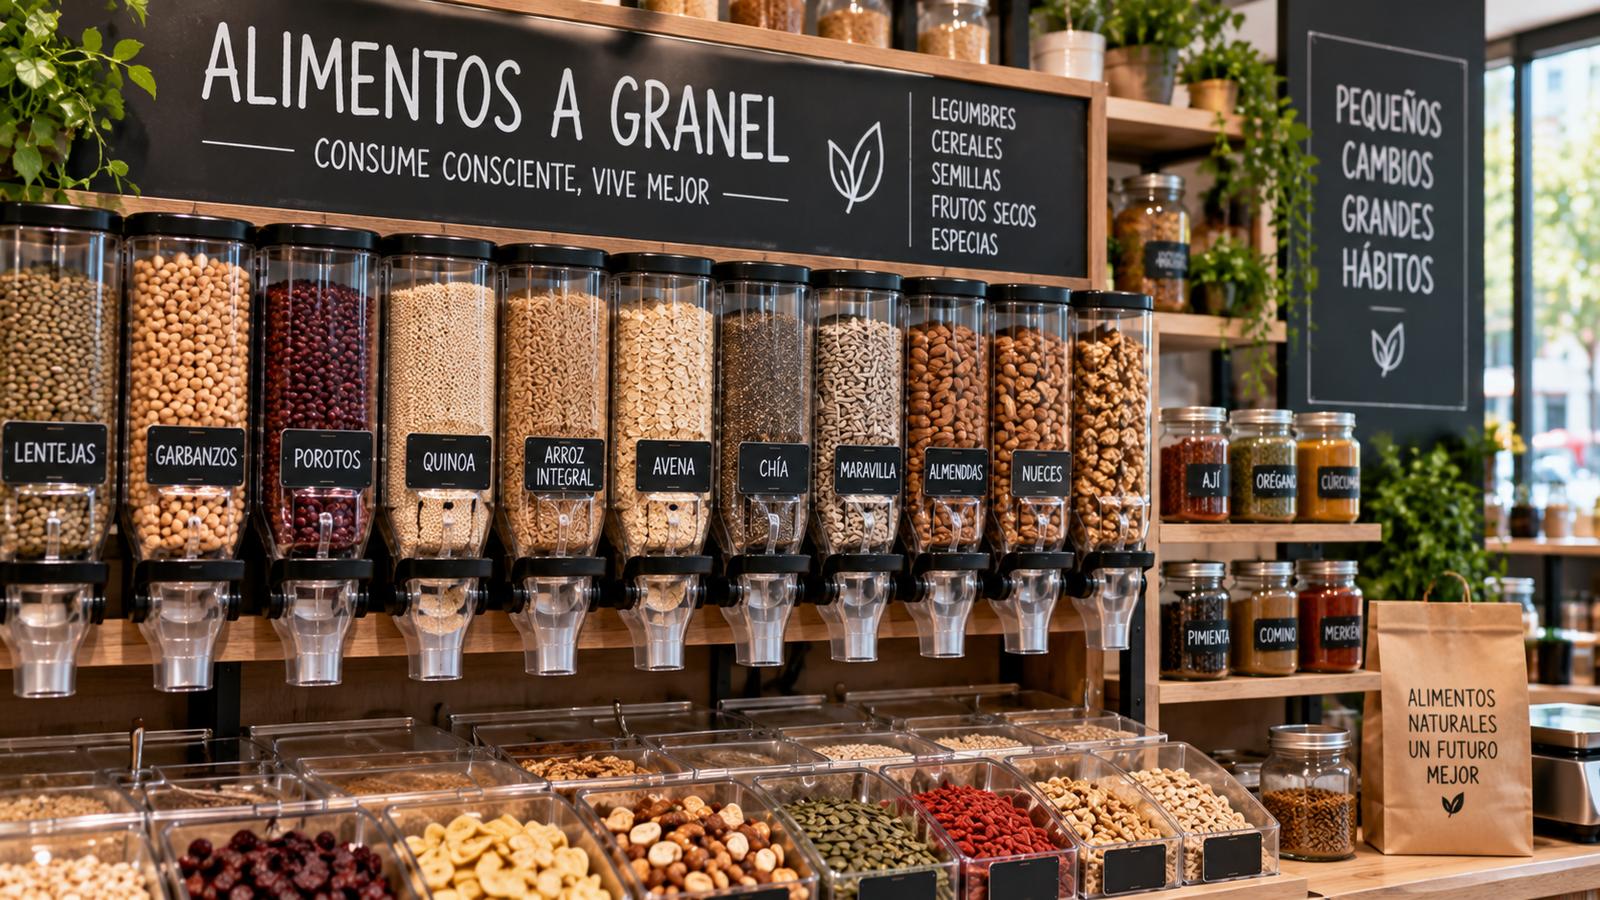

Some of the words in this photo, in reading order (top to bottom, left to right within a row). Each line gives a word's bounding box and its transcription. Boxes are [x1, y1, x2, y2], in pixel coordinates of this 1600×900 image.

[201, 21, 522, 134] ALIMENTOS
[550, 67, 583, 141] A
[610, 75, 790, 163] GRANEL
[931, 96, 1017, 131] LEGUMBRES
[1336, 84, 1442, 139] PEQUEÑOS
[931, 132, 1003, 160] CEREALES
[314, 137, 430, 178] CONSUME
[442, 151, 582, 197] CONSCIENTE,
[592, 166, 637, 198] VIVE
[647, 172, 710, 206] MEJOR
[1342, 140, 1434, 190] CAMBIOS
[931, 161, 1001, 192] SEMILLAS
[932, 194, 987, 223] FRUTOS
[993, 201, 1037, 228] SECOS
[1341, 194, 1435, 242] GRANDES
[931, 227, 999, 256] ESPECIAS
[1342, 241, 1434, 295] HÁBITOS
[14, 441, 96, 465] LENTEJAS
[155, 444, 238, 467] GARBANZOS
[294, 448, 361, 470] POROTOS
[423, 451, 476, 473] QUINOA
[544, 445, 585, 465] ARROZ
[536, 467, 594, 487] INTEGRAL
[652, 456, 696, 476] AVENA
[759, 455, 789, 478] CHÍA
[840, 461, 897, 479] MARAVILLA
[1022, 465, 1063, 483] NUECES
[1202, 470, 1221, 489] AJÍ
[1187, 629, 1230, 646] PIMIENTA
[1259, 626, 1297, 643] COMINO
[1407, 688, 1496, 708] ALIMENTOS
[1408, 713, 1498, 734] NATURALES
[1408, 740, 1430, 759] UN
[1437, 740, 1498, 760] FUTURO
[1426, 765, 1480, 785] MEJOR
